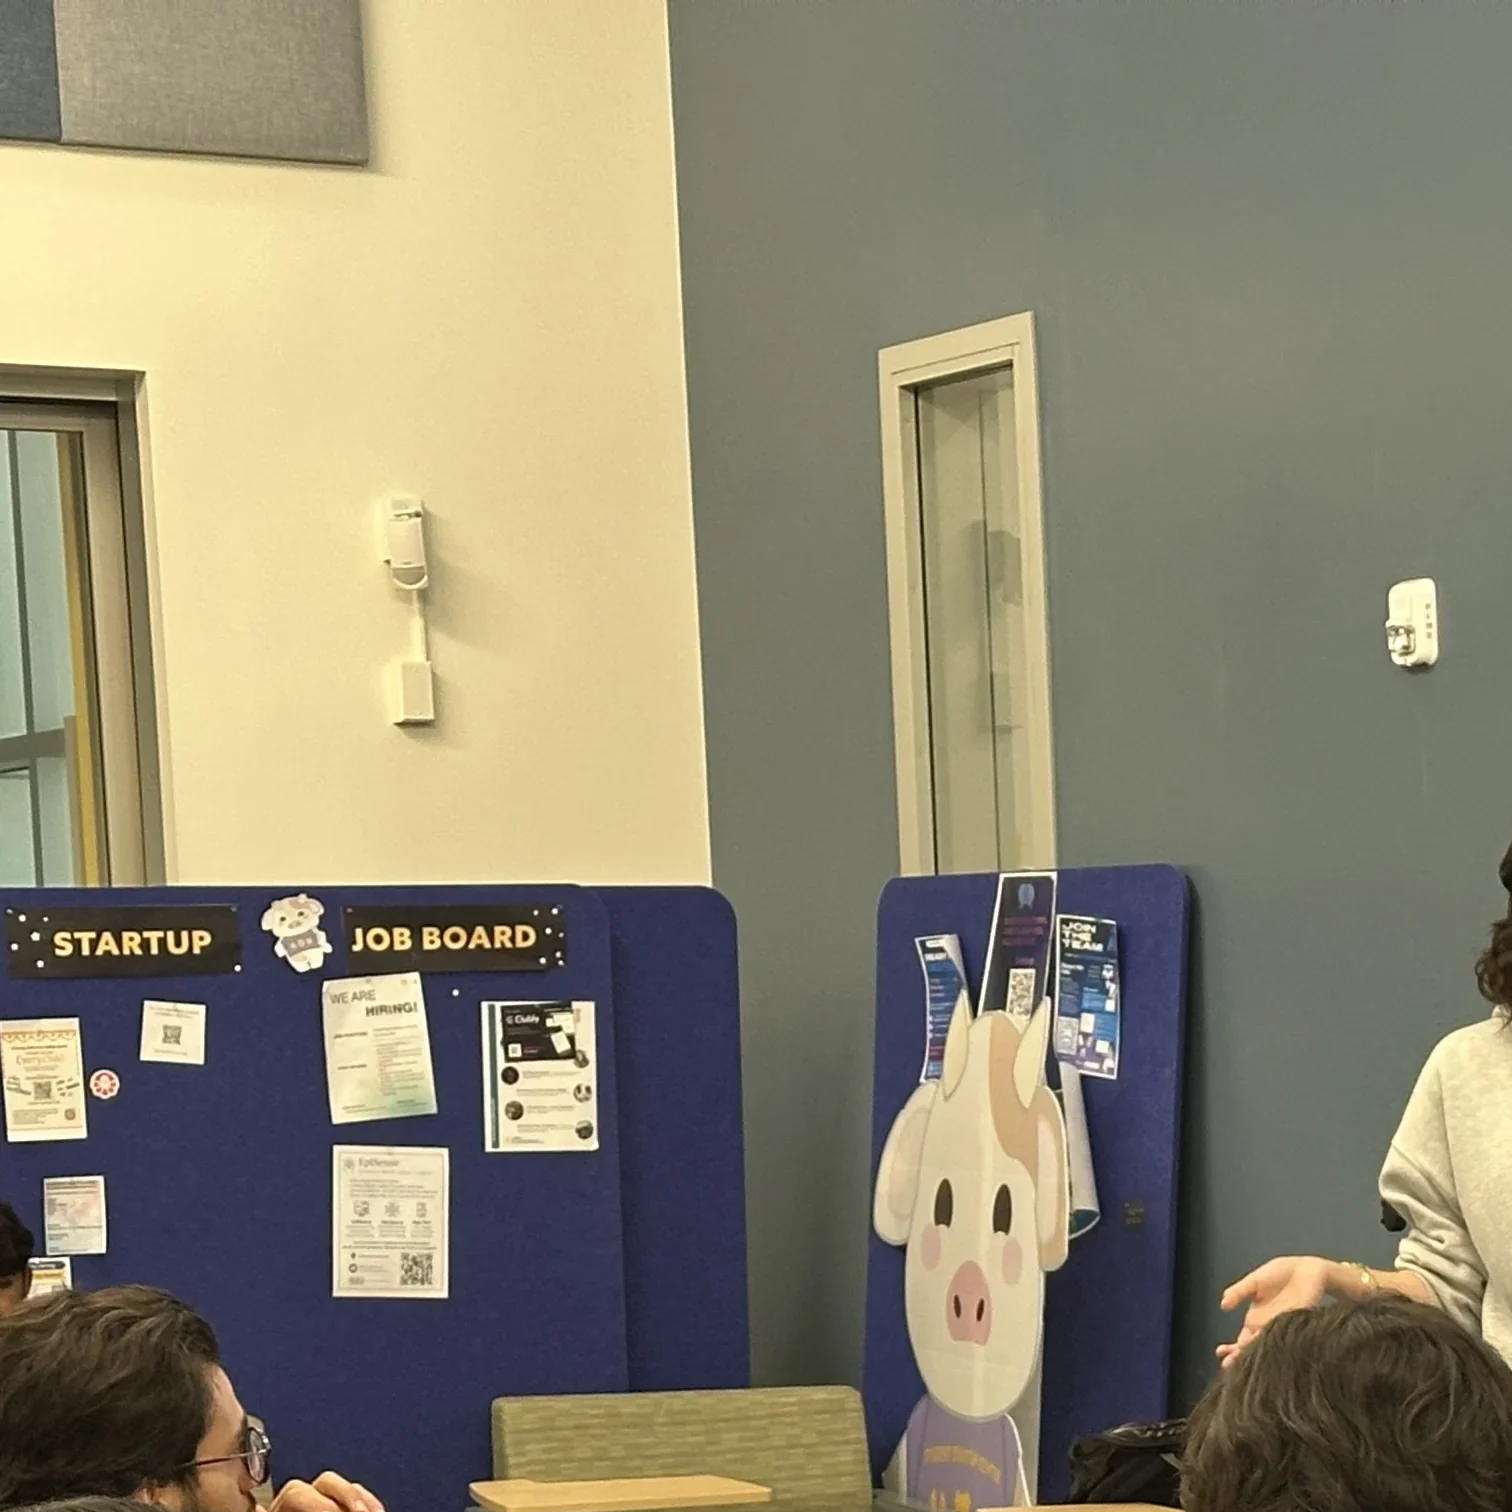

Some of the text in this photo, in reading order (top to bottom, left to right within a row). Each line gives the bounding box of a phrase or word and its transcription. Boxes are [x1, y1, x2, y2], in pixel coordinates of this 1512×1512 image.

[53, 925, 537, 957] STARTUP JOB BOARD
[329, 989, 377, 1004] WE ARE
[365, 1002, 418, 1017] HIRING!
